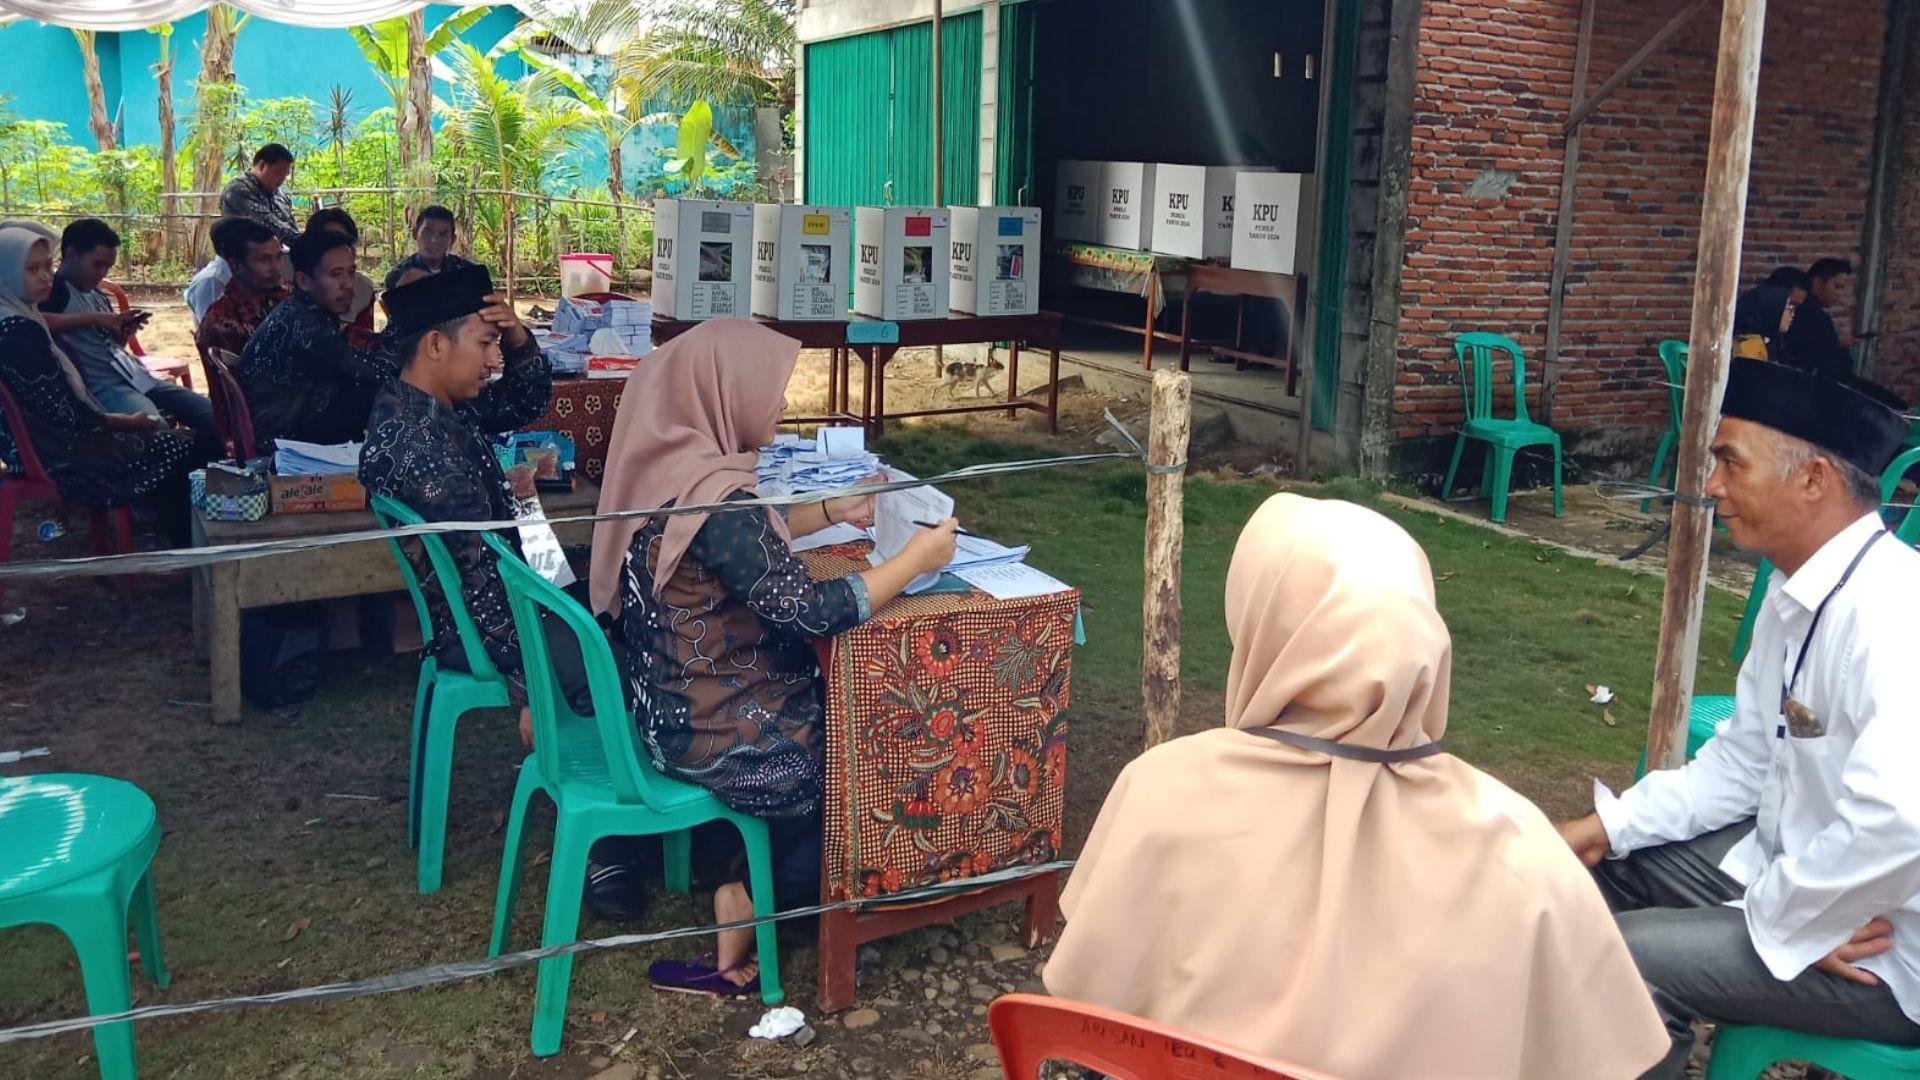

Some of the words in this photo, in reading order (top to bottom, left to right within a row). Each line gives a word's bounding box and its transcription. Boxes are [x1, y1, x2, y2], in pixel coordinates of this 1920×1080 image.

[1112, 188, 1129, 204] KPU
[1169, 192, 1189, 210] KPU
[1252, 204, 1278, 222] KPU
[657, 238, 673, 259] KPU
[757, 241, 775, 261] KPU
[861, 244, 878, 264] KPU
[952, 242, 971, 262] KPU
